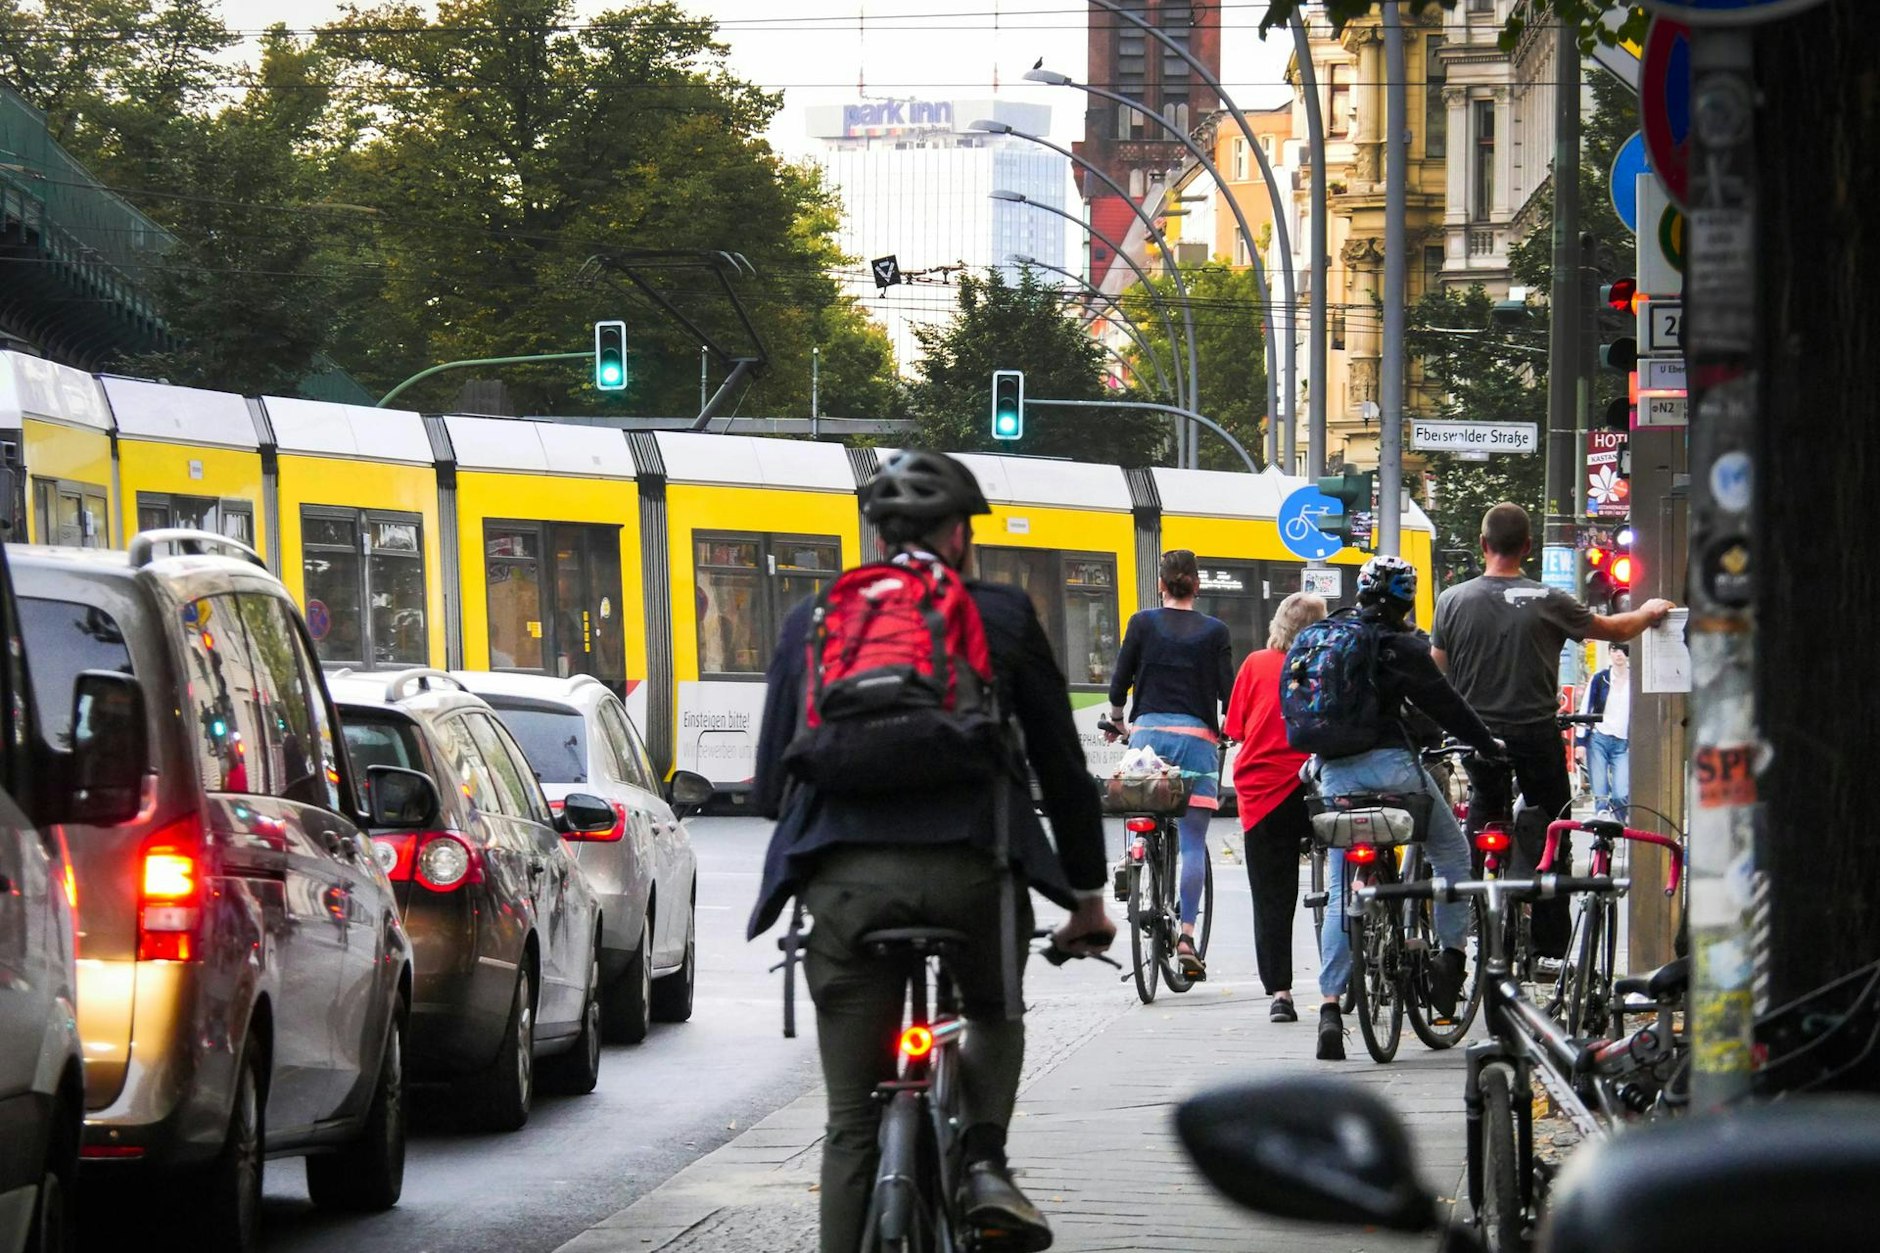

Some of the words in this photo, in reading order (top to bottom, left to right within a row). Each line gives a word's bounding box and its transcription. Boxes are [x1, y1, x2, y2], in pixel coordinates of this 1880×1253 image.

[843, 97, 905, 136] park
[909, 101, 952, 124] inn
[1660, 364, 1667, 374] U
[1491, 429, 1529, 447] Straße
[1594, 433, 1628, 448] HOT
[684, 710, 726, 730] Einsteigen
[728, 709, 750, 729] bitte!
